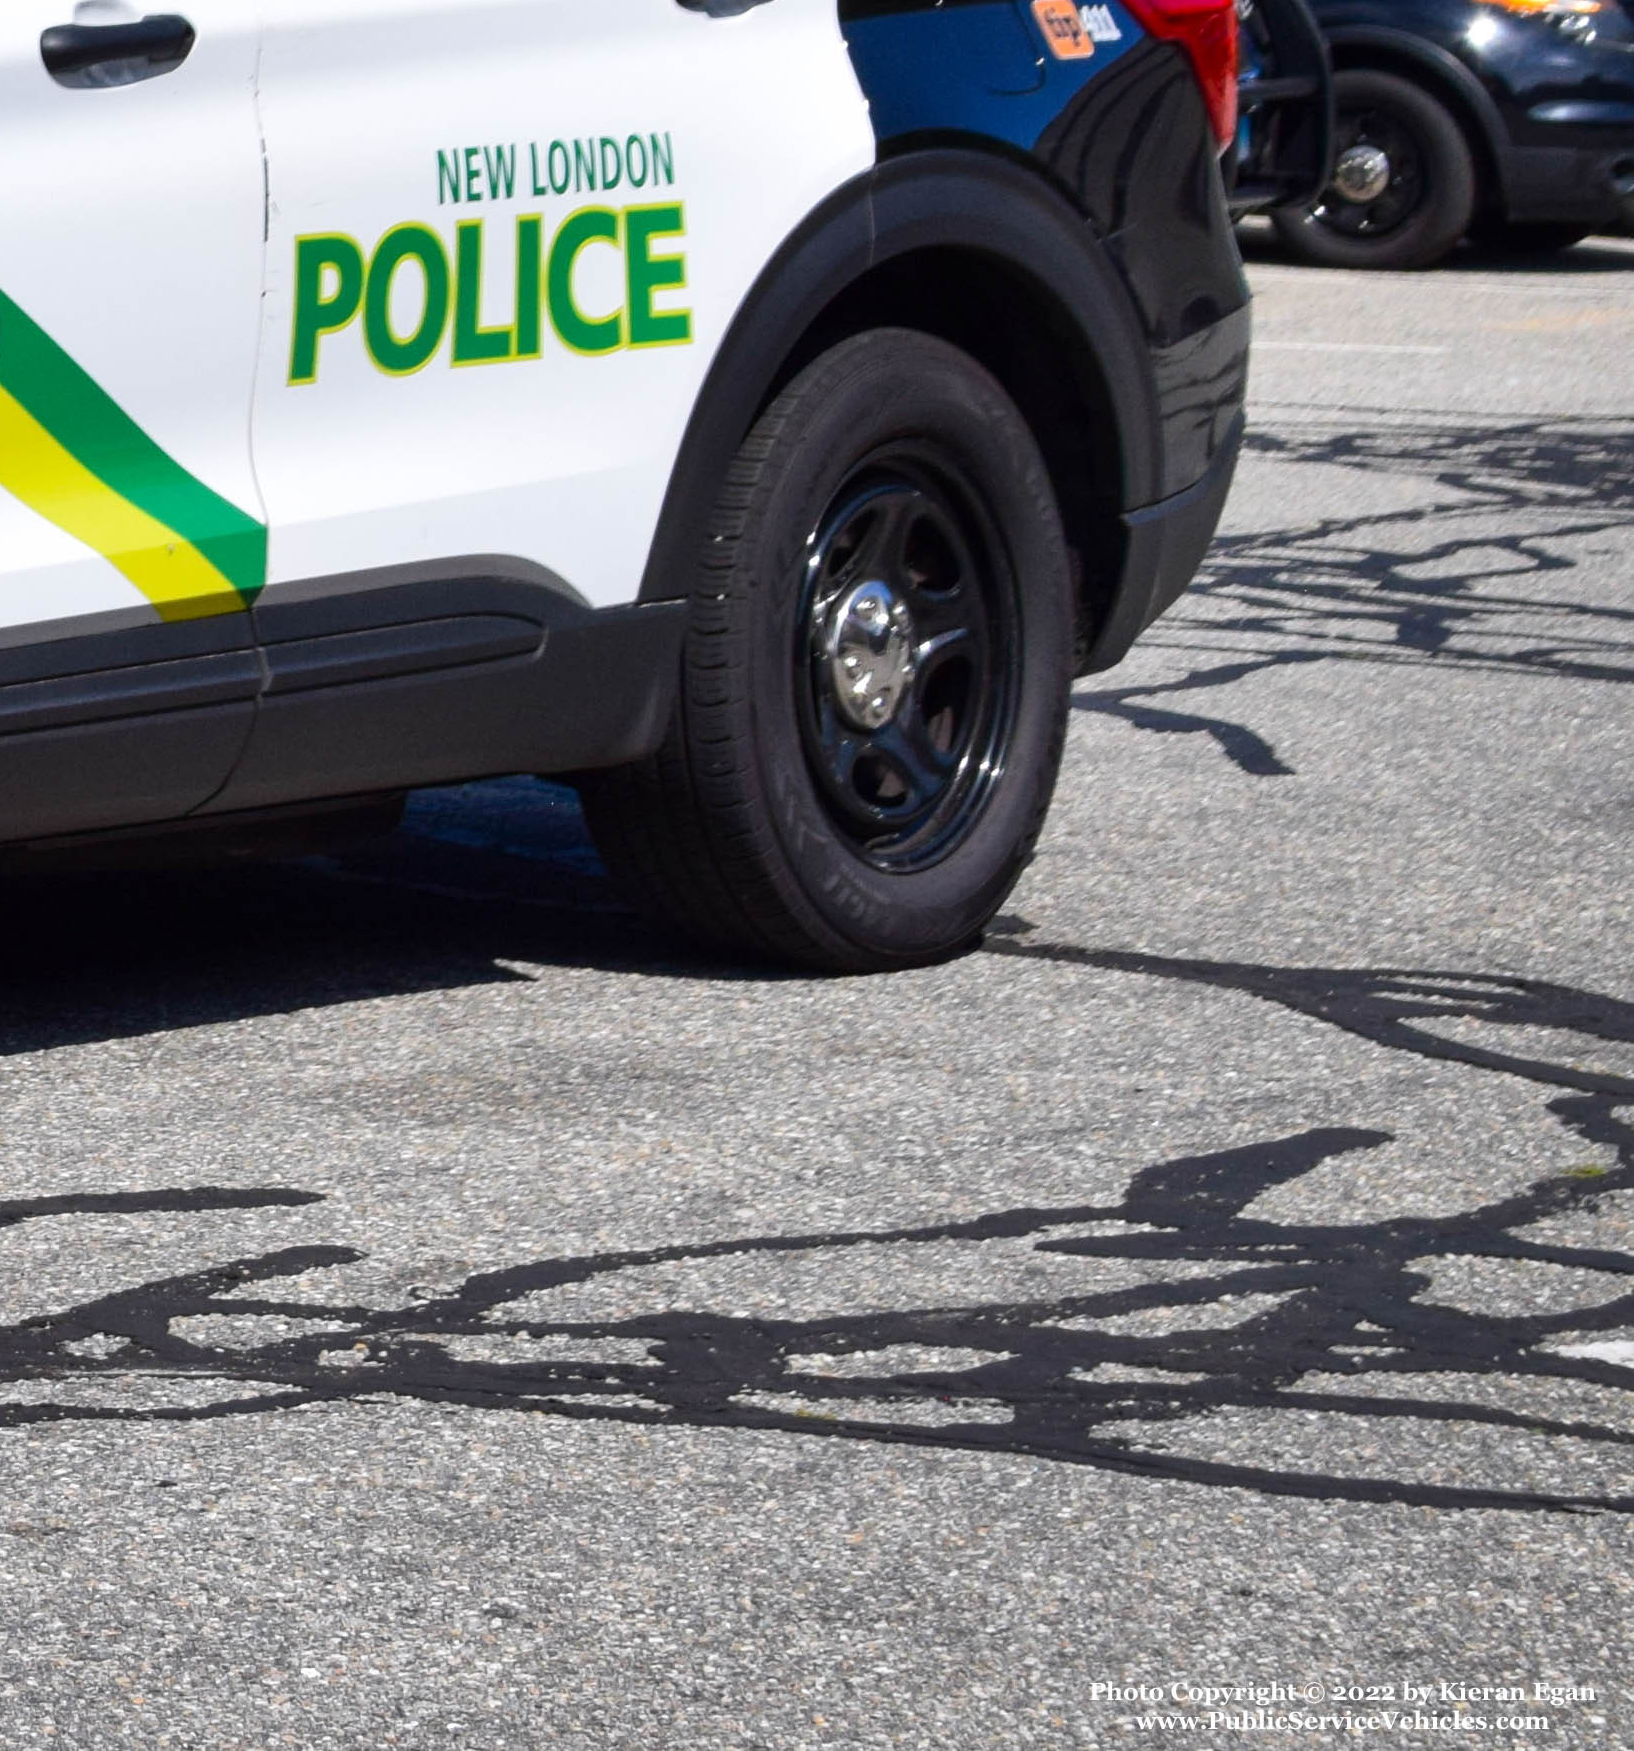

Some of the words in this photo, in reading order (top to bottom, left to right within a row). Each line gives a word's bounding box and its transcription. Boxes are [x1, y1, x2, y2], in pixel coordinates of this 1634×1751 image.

[437, 142, 517, 205] NEW
[531, 131, 675, 198] LONDON
[286, 200, 695, 387] POLICE
